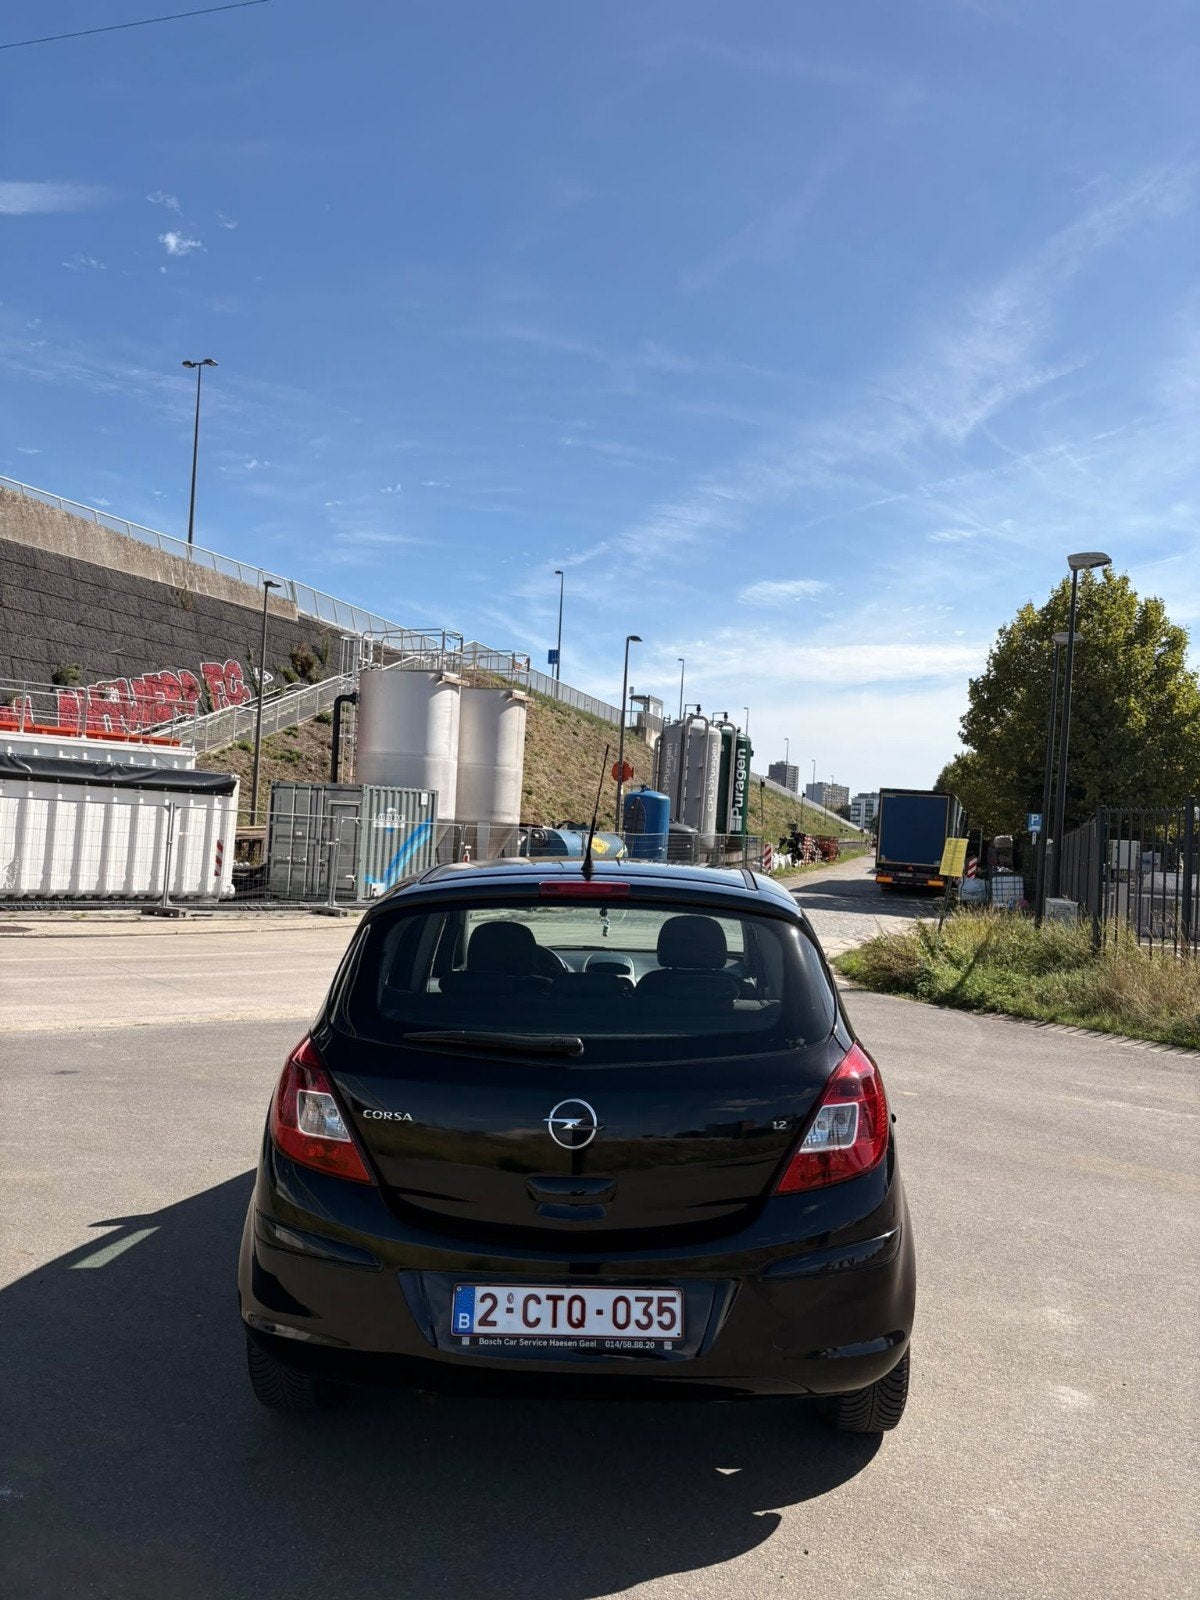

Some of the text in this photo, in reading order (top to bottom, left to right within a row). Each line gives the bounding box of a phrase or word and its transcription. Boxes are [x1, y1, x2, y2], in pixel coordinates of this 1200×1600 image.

[709, 742, 718, 783] Puragen
[731, 748, 747, 820] Puragen
[1031, 814, 1039, 825] P
[362, 1109, 413, 1121] CORSA
[458, 1313, 470, 1328] B
[479, 1337, 502, 1346] Bosch
[503, 1338, 517, 1346] Car
[519, 1339, 548, 1347] Service
[549, 1339, 577, 1348] Haesen
[579, 1340, 597, 1348] Geel
